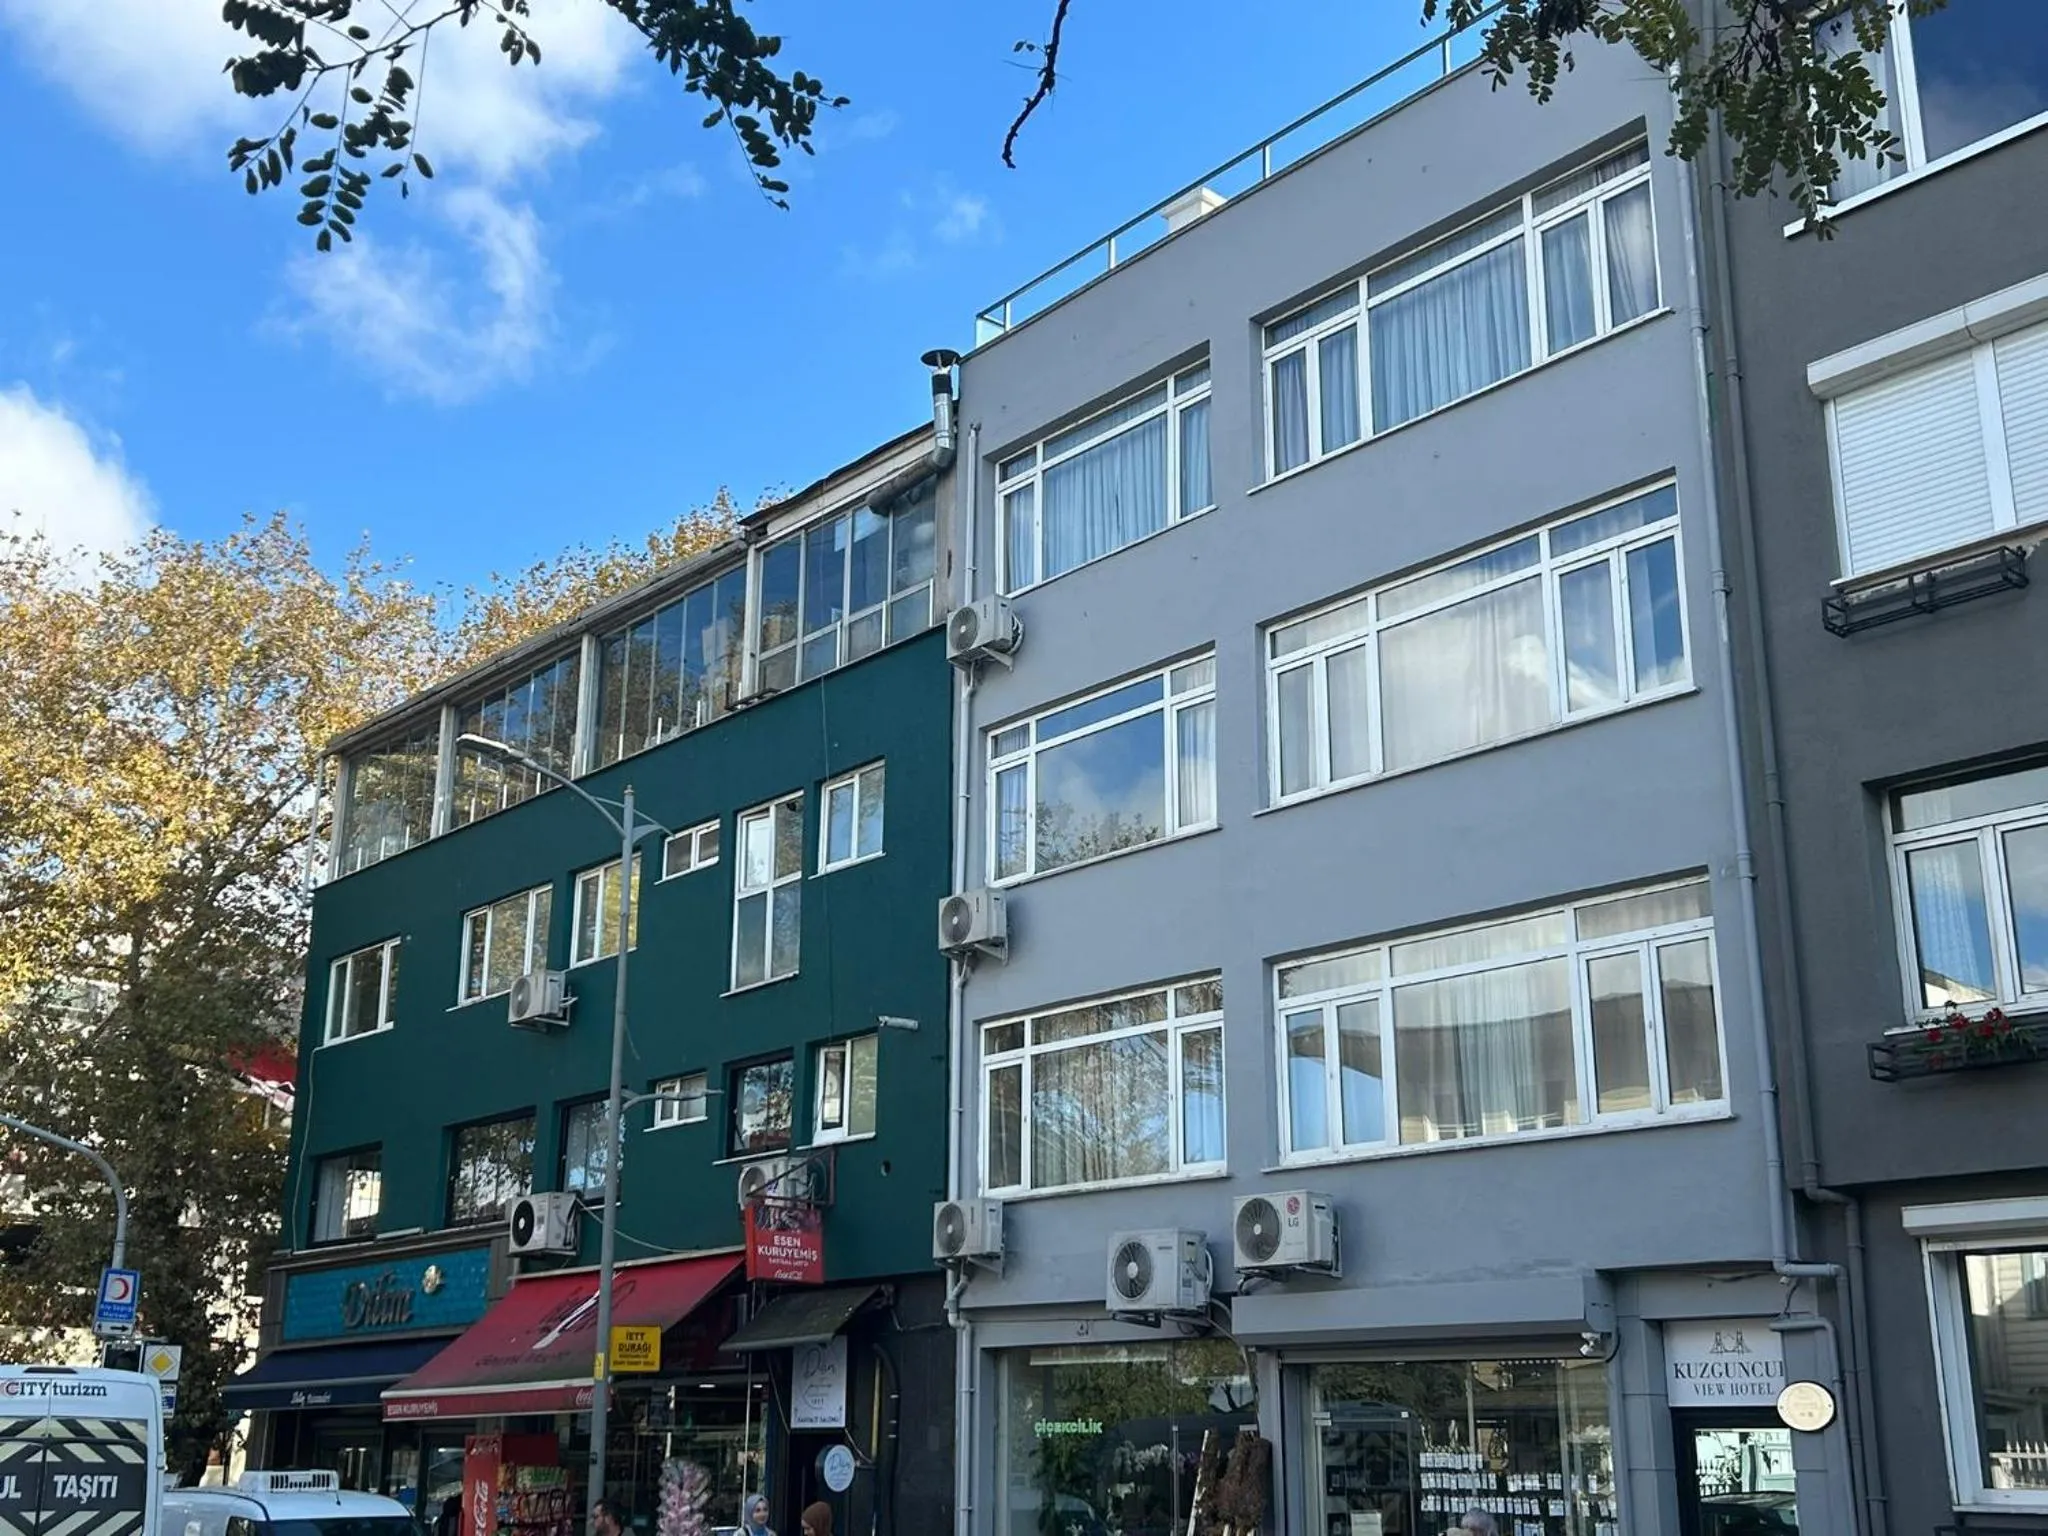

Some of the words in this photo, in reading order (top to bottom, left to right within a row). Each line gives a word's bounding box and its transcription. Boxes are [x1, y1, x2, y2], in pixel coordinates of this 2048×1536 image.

[1288, 1217, 1299, 1228] LG
[773, 1235, 801, 1247] ESEN
[757, 1245, 818, 1262] KURUYEMİŞ
[5, 1382, 50, 1396] CITY
[52, 1382, 107, 1397] turizm
[1694, 1383, 1726, 1396] VIEW
[1731, 1382, 1775, 1396] HOTEL
[53, 1475, 118, 1504] TAŞITI
